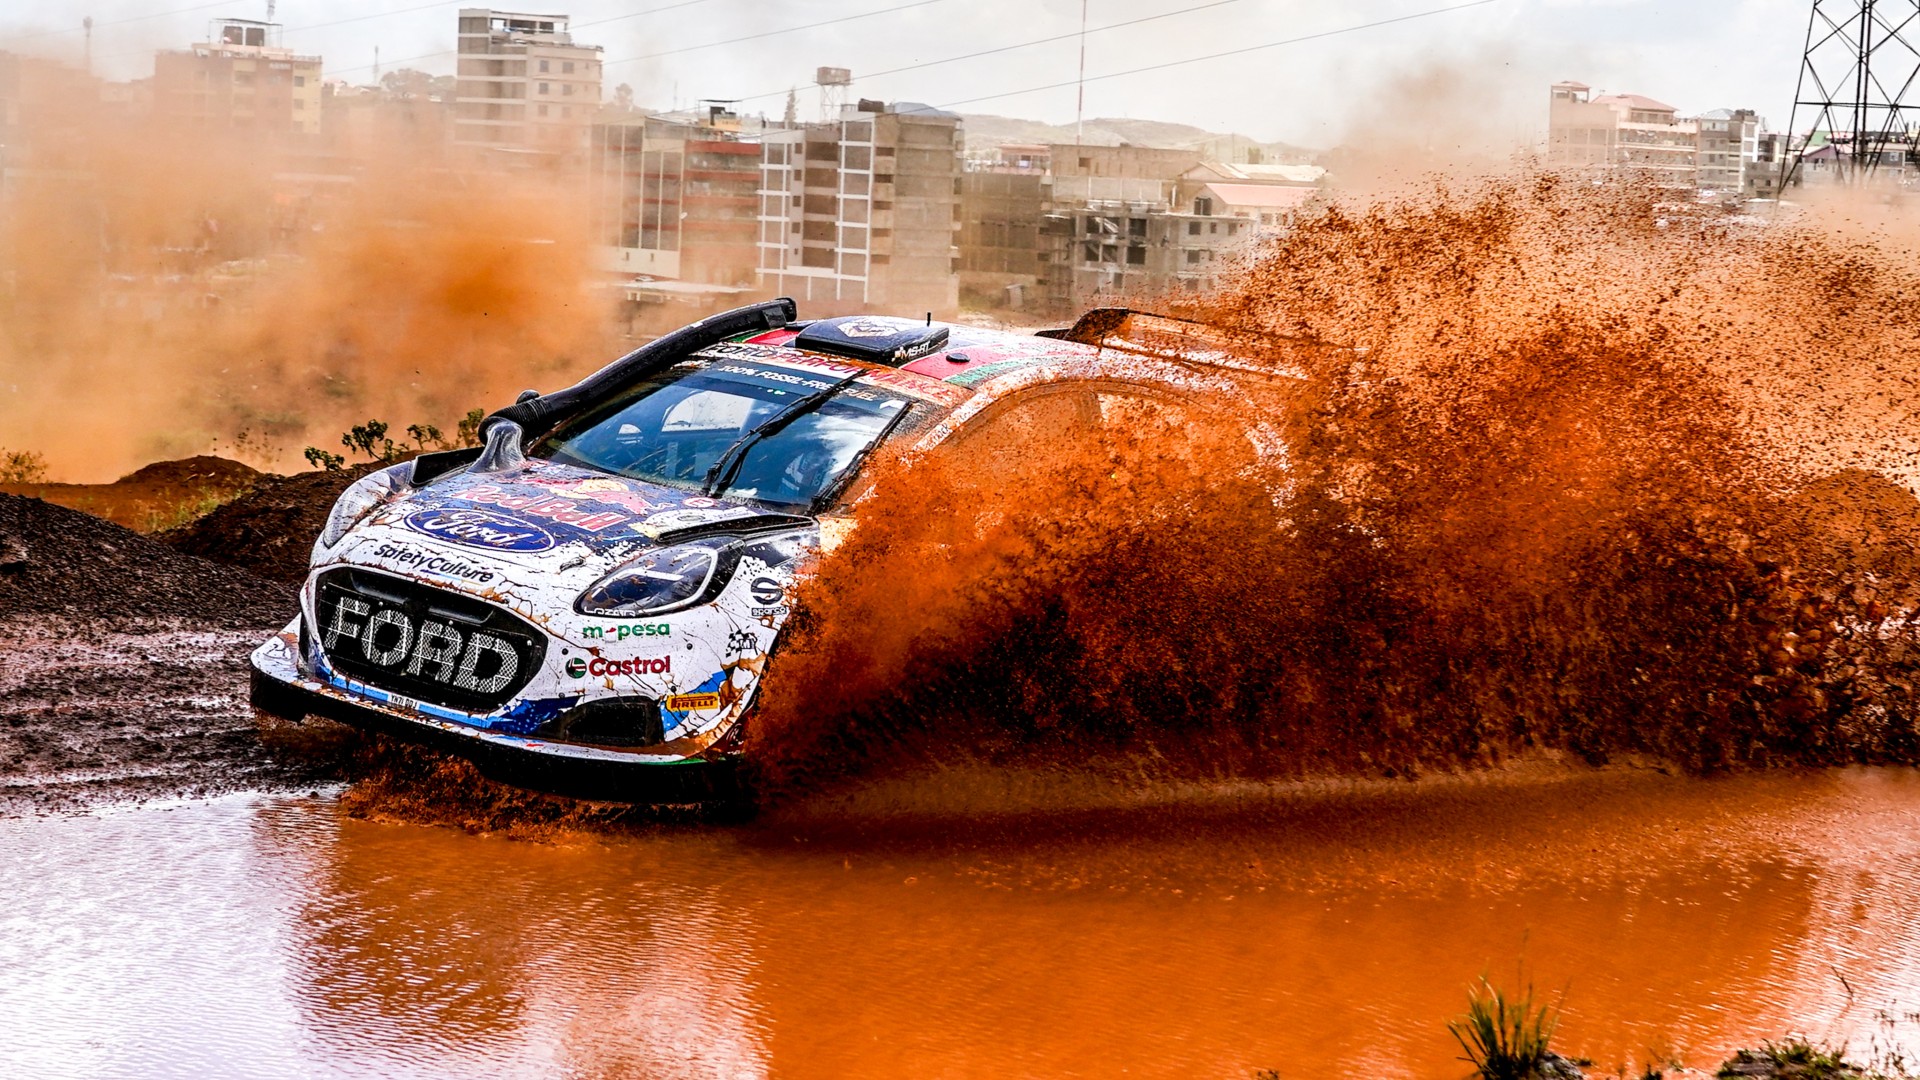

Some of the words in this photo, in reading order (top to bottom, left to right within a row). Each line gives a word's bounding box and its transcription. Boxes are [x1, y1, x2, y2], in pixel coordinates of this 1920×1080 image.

[900, 341, 931, 358] MS-RT
[718, 366, 759, 376] 100%
[450, 485, 554, 510] Red
[521, 498, 631, 532] Bull
[424, 511, 534, 547] Ford
[752, 606, 787, 616] sparco
[324, 596, 519, 693] FORD
[588, 655, 671, 677] Castrol
[671, 696, 718, 709] PIRELLI
